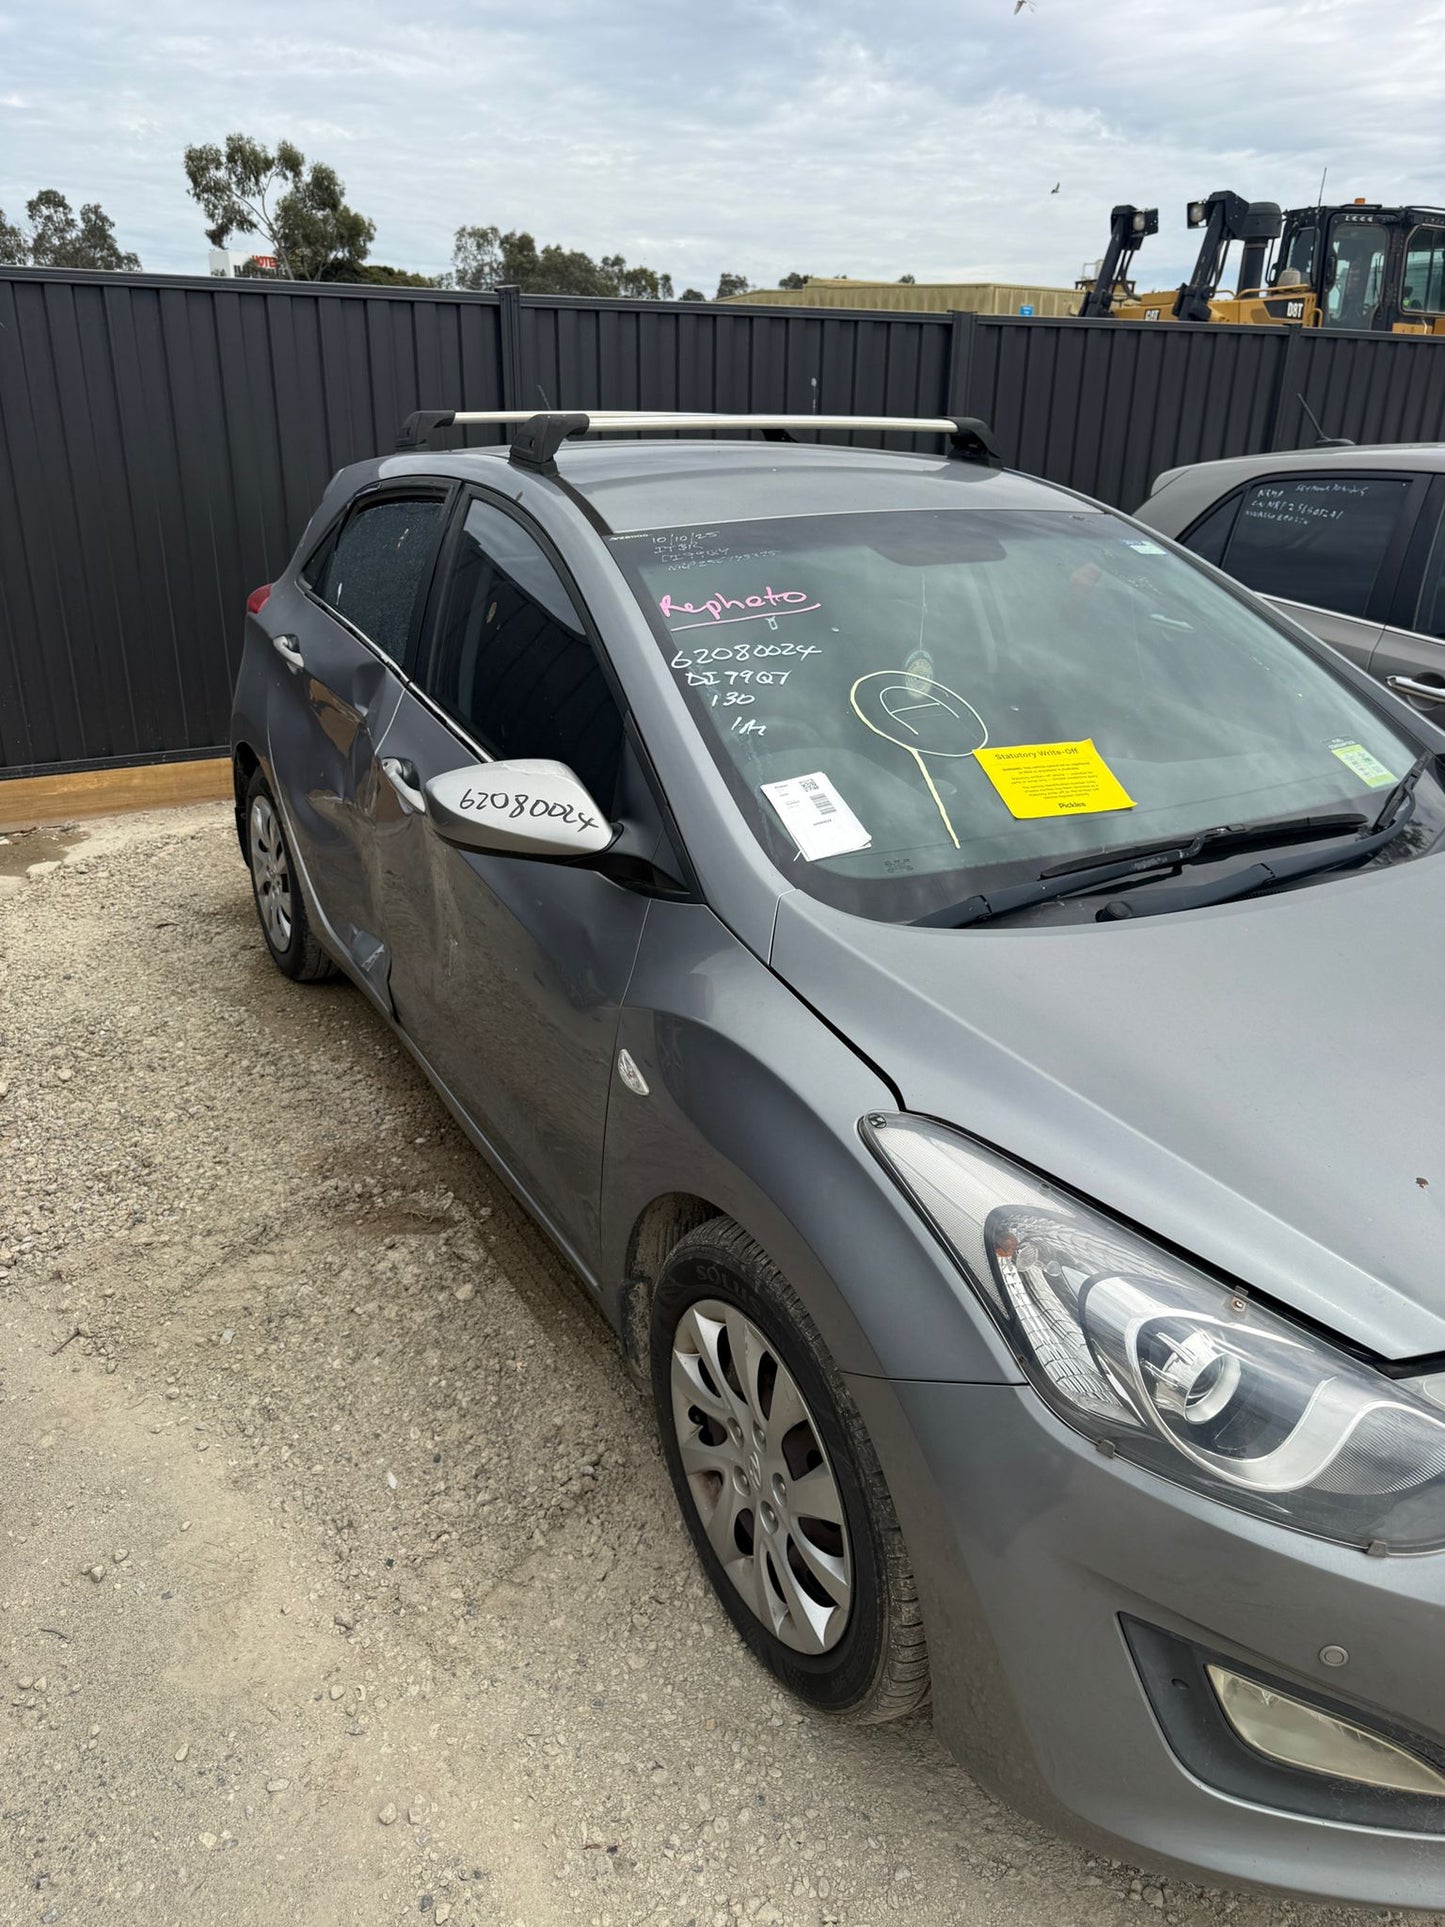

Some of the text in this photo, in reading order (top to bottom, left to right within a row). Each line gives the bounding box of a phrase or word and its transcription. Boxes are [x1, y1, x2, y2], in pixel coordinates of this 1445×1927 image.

[1286, 303, 1303, 318] D8T
[670, 643, 823, 669] 62080024
[459, 788, 600, 832] 62080024
[1058, 801, 1087, 809] Pickles
